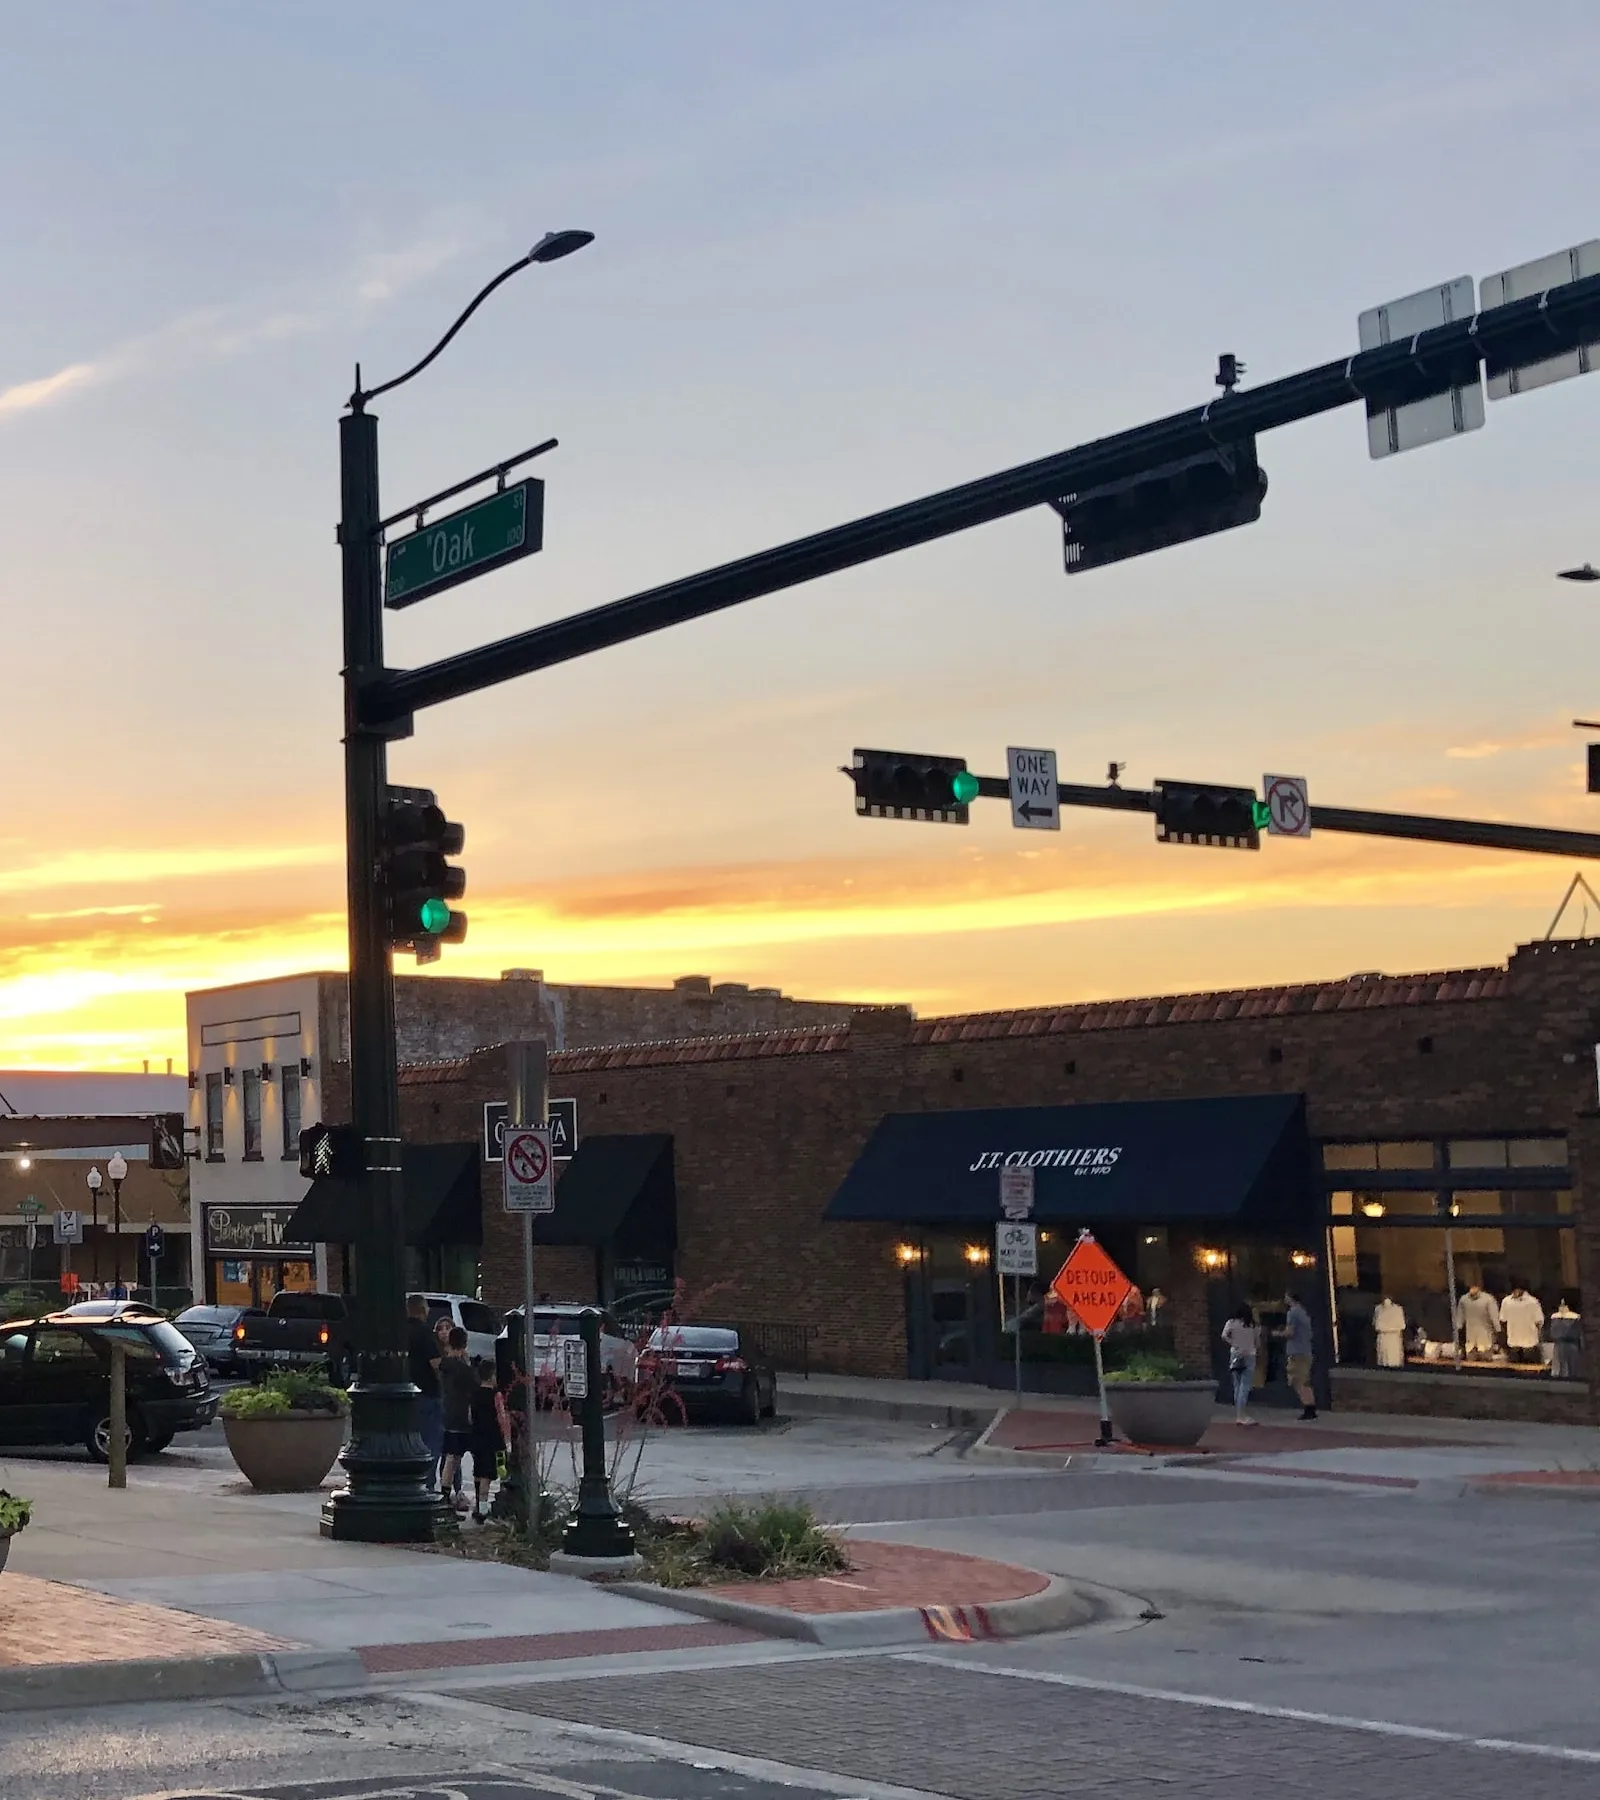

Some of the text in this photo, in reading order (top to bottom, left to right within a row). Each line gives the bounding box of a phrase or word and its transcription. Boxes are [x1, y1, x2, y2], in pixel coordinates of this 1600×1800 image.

[432, 521, 475, 572] Oak
[1016, 754, 1048, 774] ONE
[1017, 776, 1050, 796] WAY
[969, 1147, 1123, 1172] J.T. CLOTHIERS
[1066, 1269, 1116, 1285] DETOUR
[1073, 1291, 1117, 1306] AHEAD
